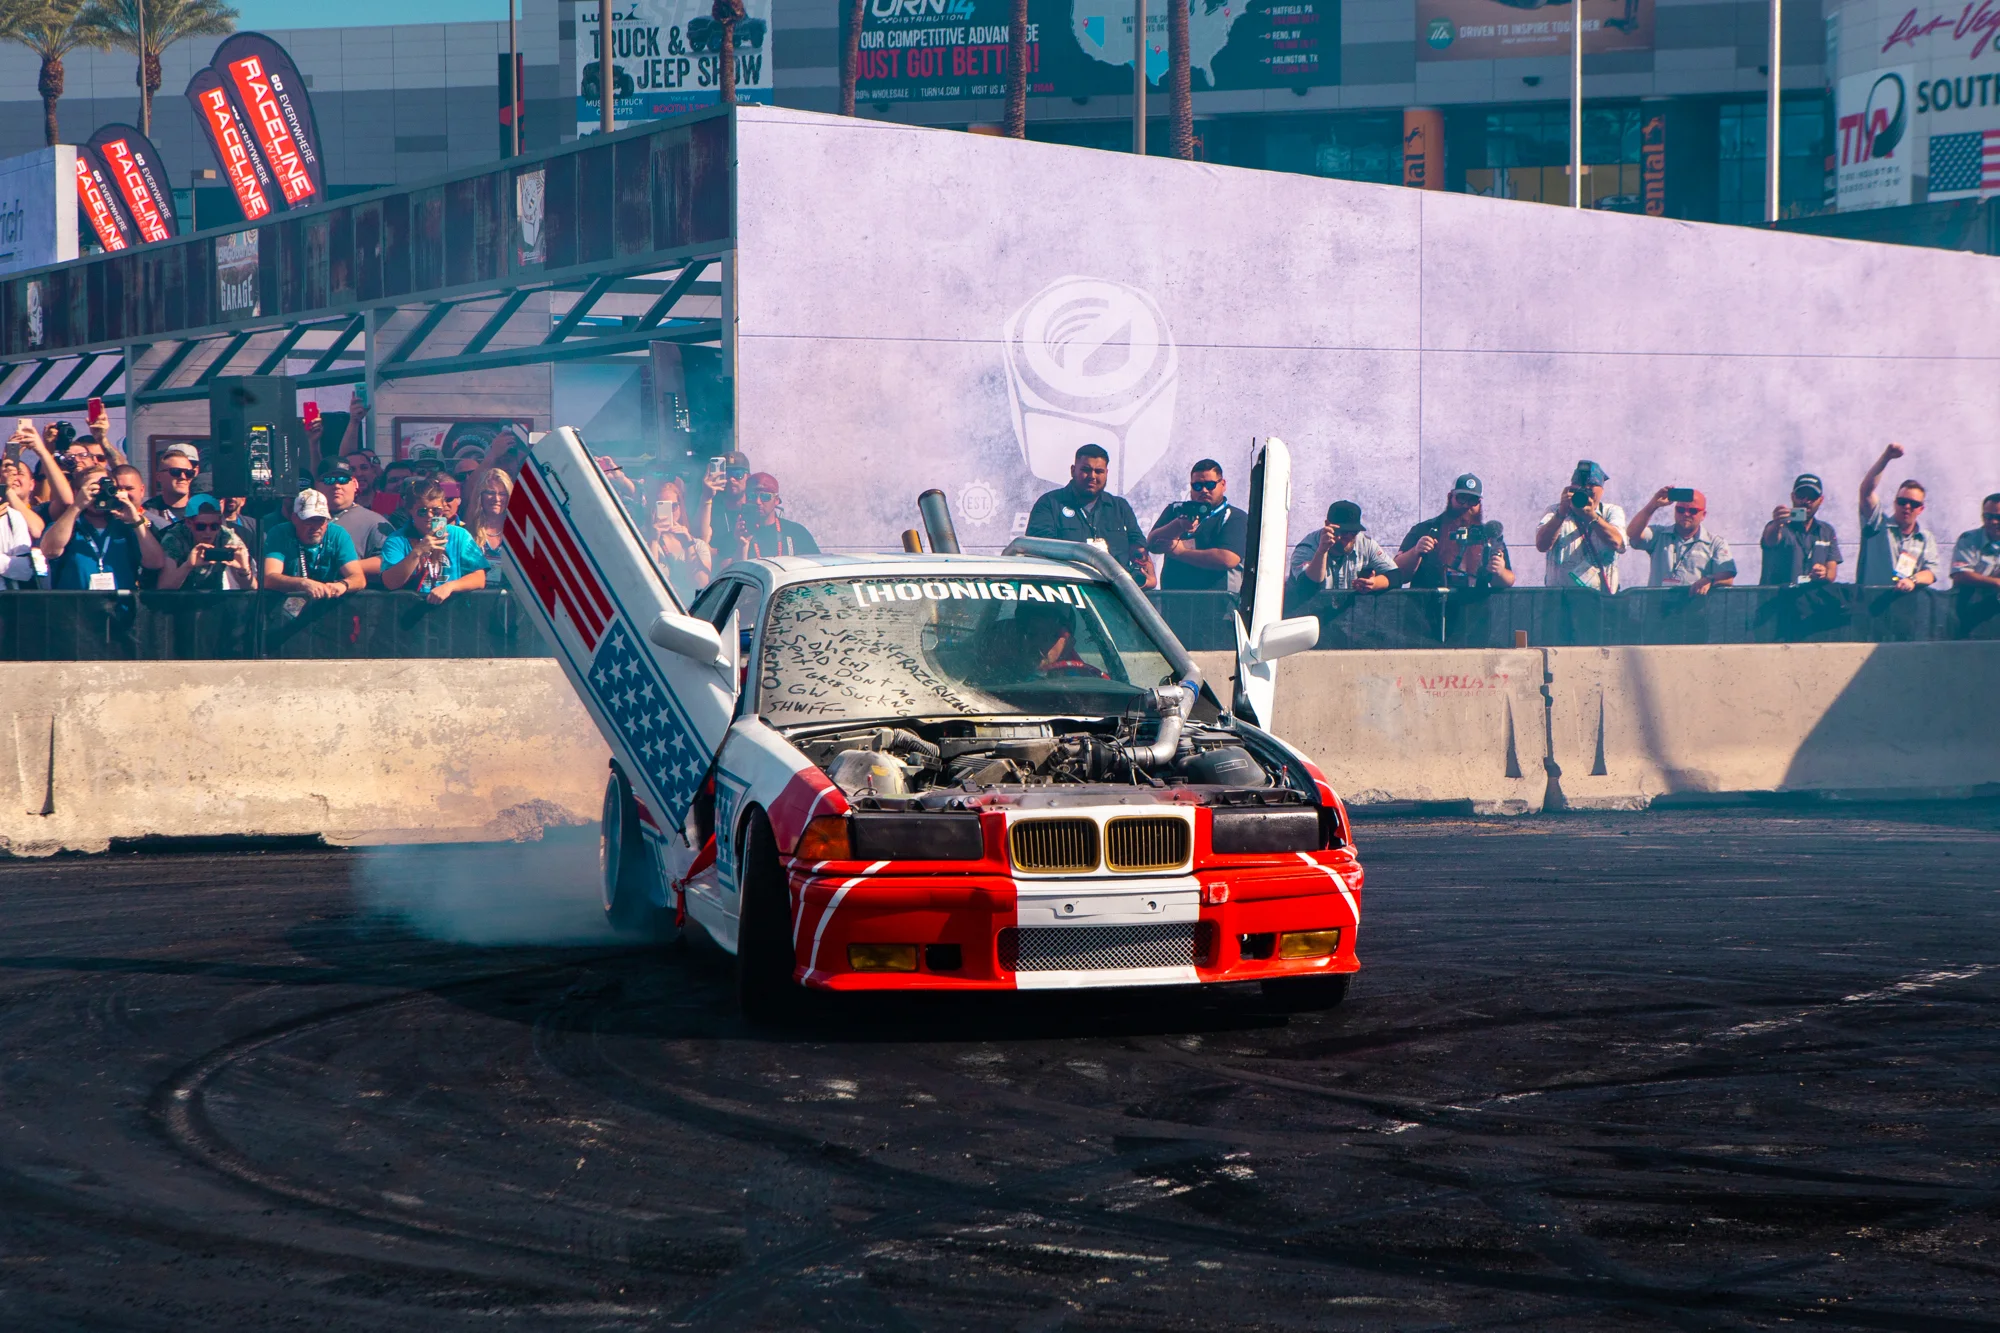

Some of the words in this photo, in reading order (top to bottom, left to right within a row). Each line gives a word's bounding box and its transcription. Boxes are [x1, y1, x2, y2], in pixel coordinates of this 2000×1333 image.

[582, 12, 623, 22] LUD
[892, 14, 964, 24] DISTRIBUTION
[1304, 4, 1313, 14] PA
[667, 25, 686, 56] &
[860, 31, 884, 49] OUR
[887, 27, 965, 48] COMPETITIVE
[968, 23, 1040, 44] ADVANGE
[1459, 26, 1494, 38] DRIVEN
[1497, 25, 1508, 36] TO
[1511, 22, 1549, 35] INSPIRE
[637, 57, 690, 90] JEEP
[907, 47, 947, 78] GOT
[1309, 54, 1319, 63] TX
[621, 98, 644, 106] TRUCK
[871, 87, 909, 99] WHOLESALE
[971, 84, 988, 96] VISIT
[989, 84, 998, 95] US
[240, 58, 311, 197] RACELINE
[270, 73, 284, 92] GO
[279, 93, 316, 164] EVERYWHERE
[1839, 107, 1895, 167] TIA
[208, 90, 267, 216] RACELINE
[134, 152, 146, 166] GO
[141, 166, 172, 220] EVERYWHERE
[265, 141, 296, 200] WHEELS
[92, 169, 103, 183] GO
[99, 183, 128, 231] EVERYWHERE
[111, 140, 168, 243] RACELINE
[229, 165, 256, 219] WHEELS
[220, 273, 254, 312] GARAGE
[967, 496, 990, 511] EST.
